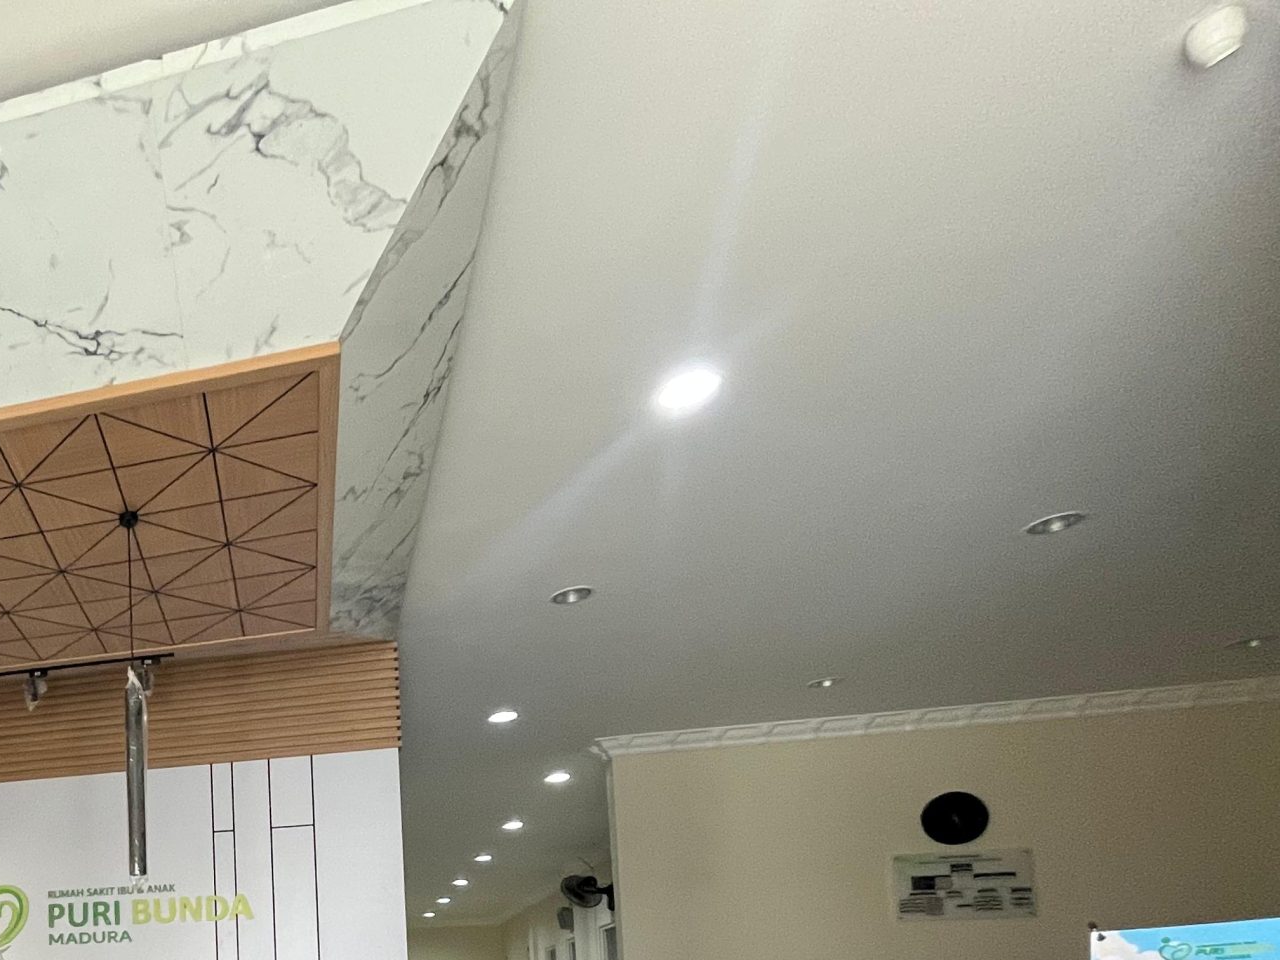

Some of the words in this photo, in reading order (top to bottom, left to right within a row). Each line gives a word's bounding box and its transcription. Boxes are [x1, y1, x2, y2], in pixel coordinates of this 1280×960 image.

[48, 889, 84, 899] RUMAH
[87, 887, 115, 897] SAKIT
[118, 886, 135, 895] IBU
[146, 884, 176, 894] ANAK
[48, 900, 121, 928] PURI
[131, 894, 255, 925] BUNDA
[48, 930, 132, 946] MADURA
